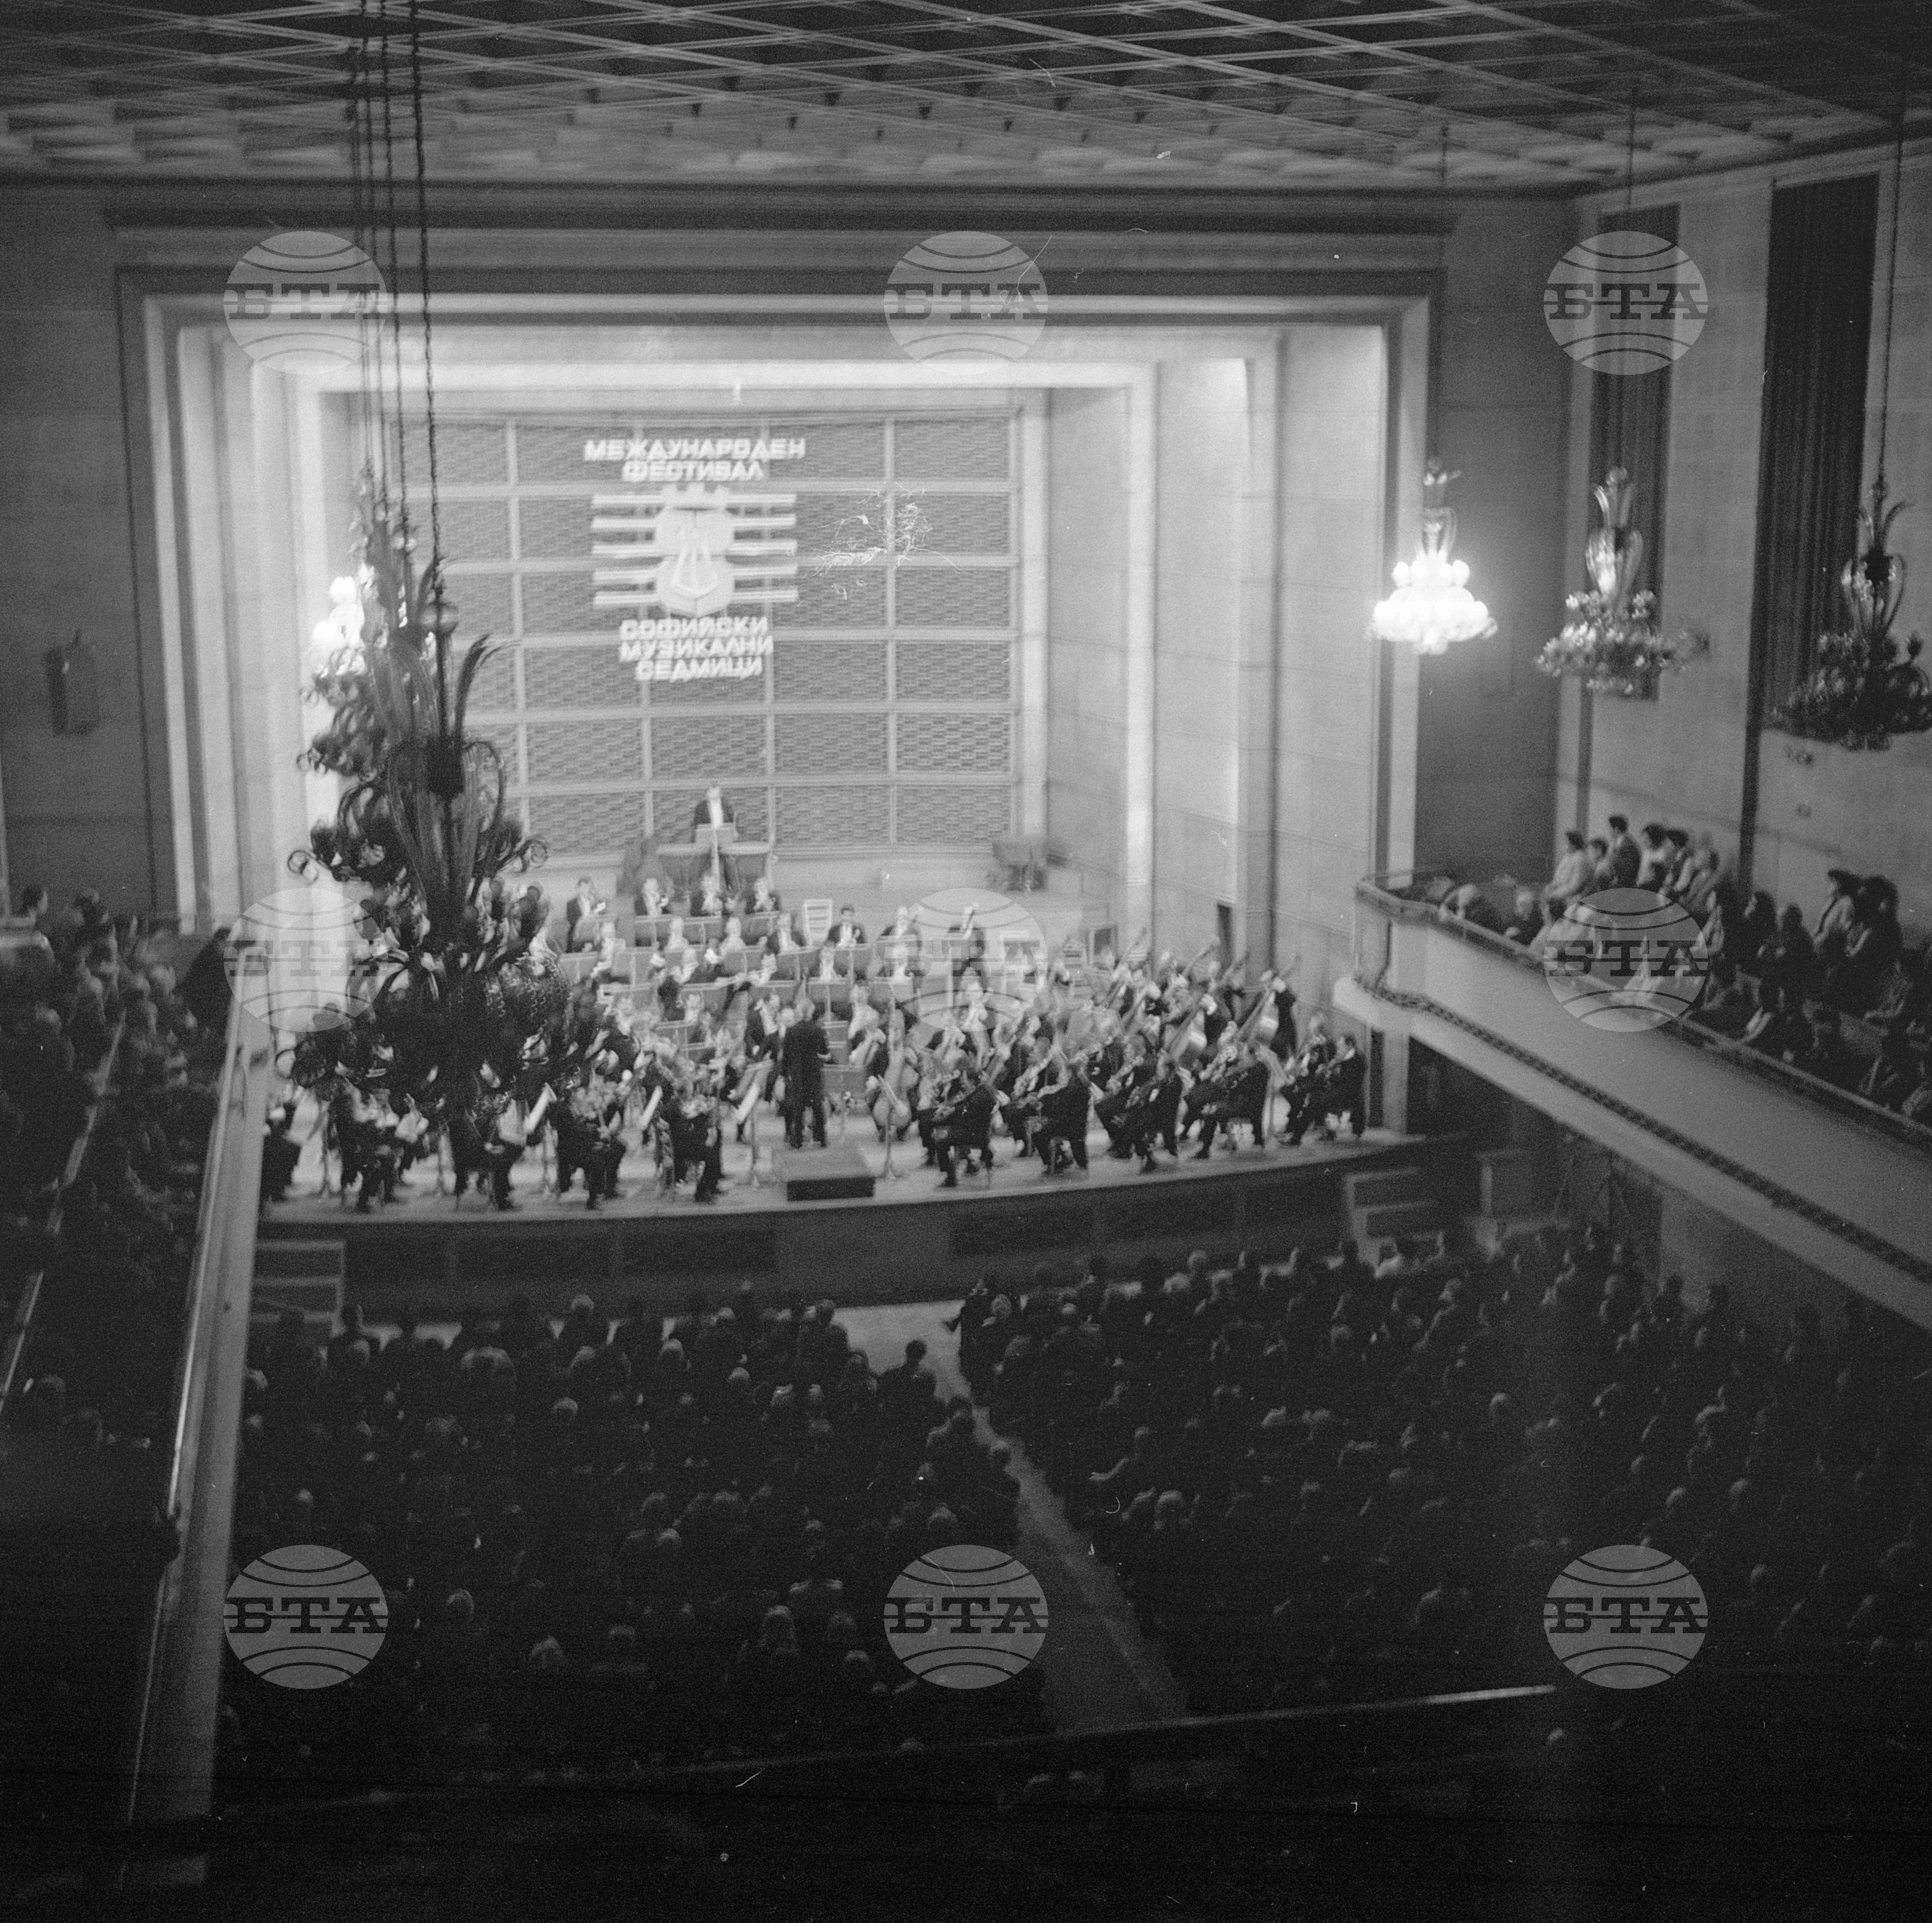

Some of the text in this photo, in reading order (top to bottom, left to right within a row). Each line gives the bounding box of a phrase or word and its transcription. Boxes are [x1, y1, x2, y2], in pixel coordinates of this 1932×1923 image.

[583, 438, 806, 461] МЕЖДУНАРОДЕН
[622, 460, 764, 482] ФЕСТИВАЛ
[619, 616, 768, 641] СОФИЙСКИ
[619, 635, 773, 662] МУЗИКАЛНИ
[635, 655, 763, 682] СЕДМИЦИ
